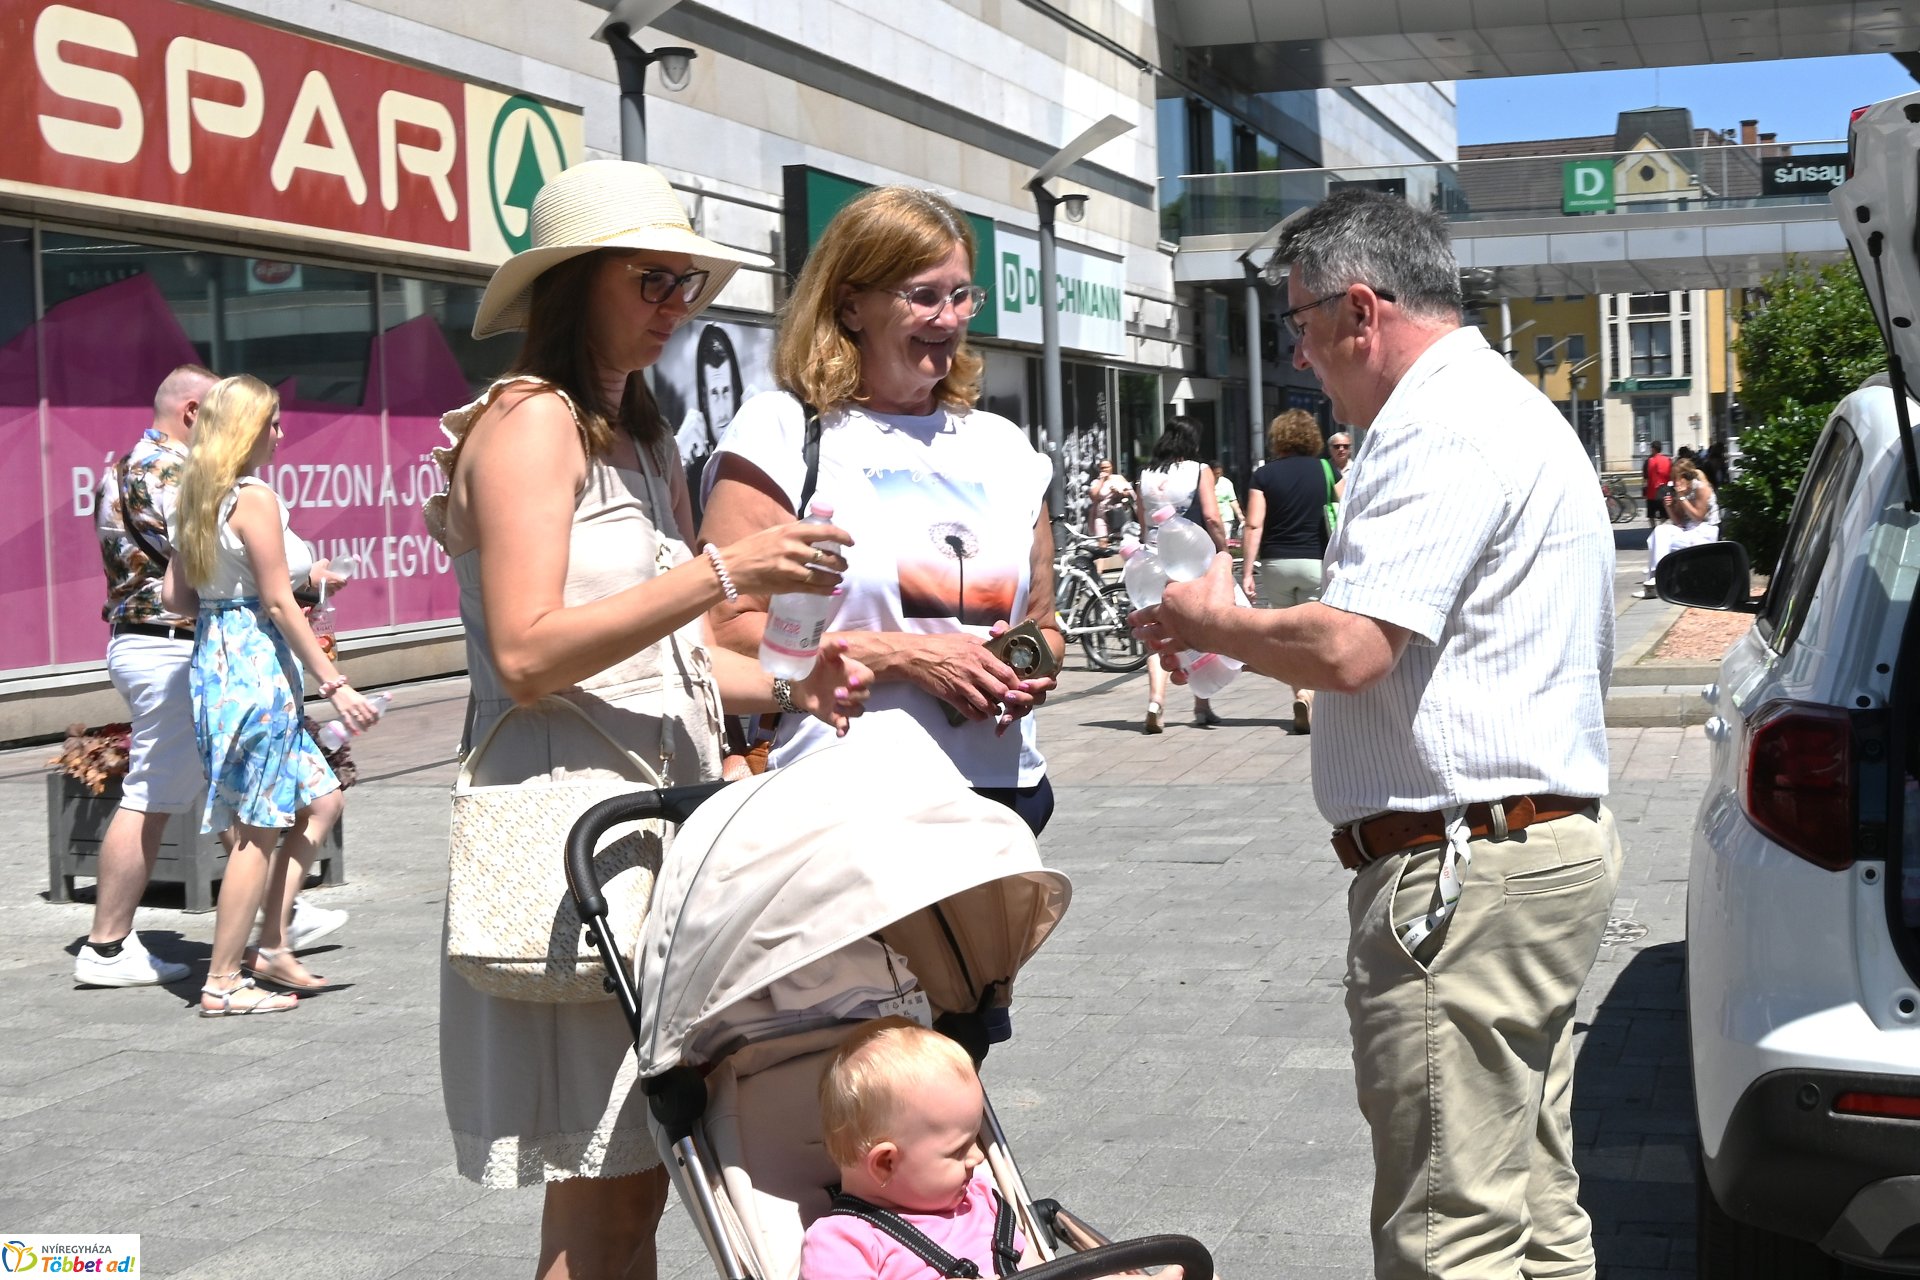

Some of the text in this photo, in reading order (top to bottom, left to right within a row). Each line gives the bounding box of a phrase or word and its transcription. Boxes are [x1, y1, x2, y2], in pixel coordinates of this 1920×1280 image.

[33, 4, 458, 222] SPAR
[1574, 167, 1605, 196] D
[1774, 162, 1846, 186] sinsay
[1024, 267, 1121, 322] DCHMANN
[378, 464, 399, 506] A
